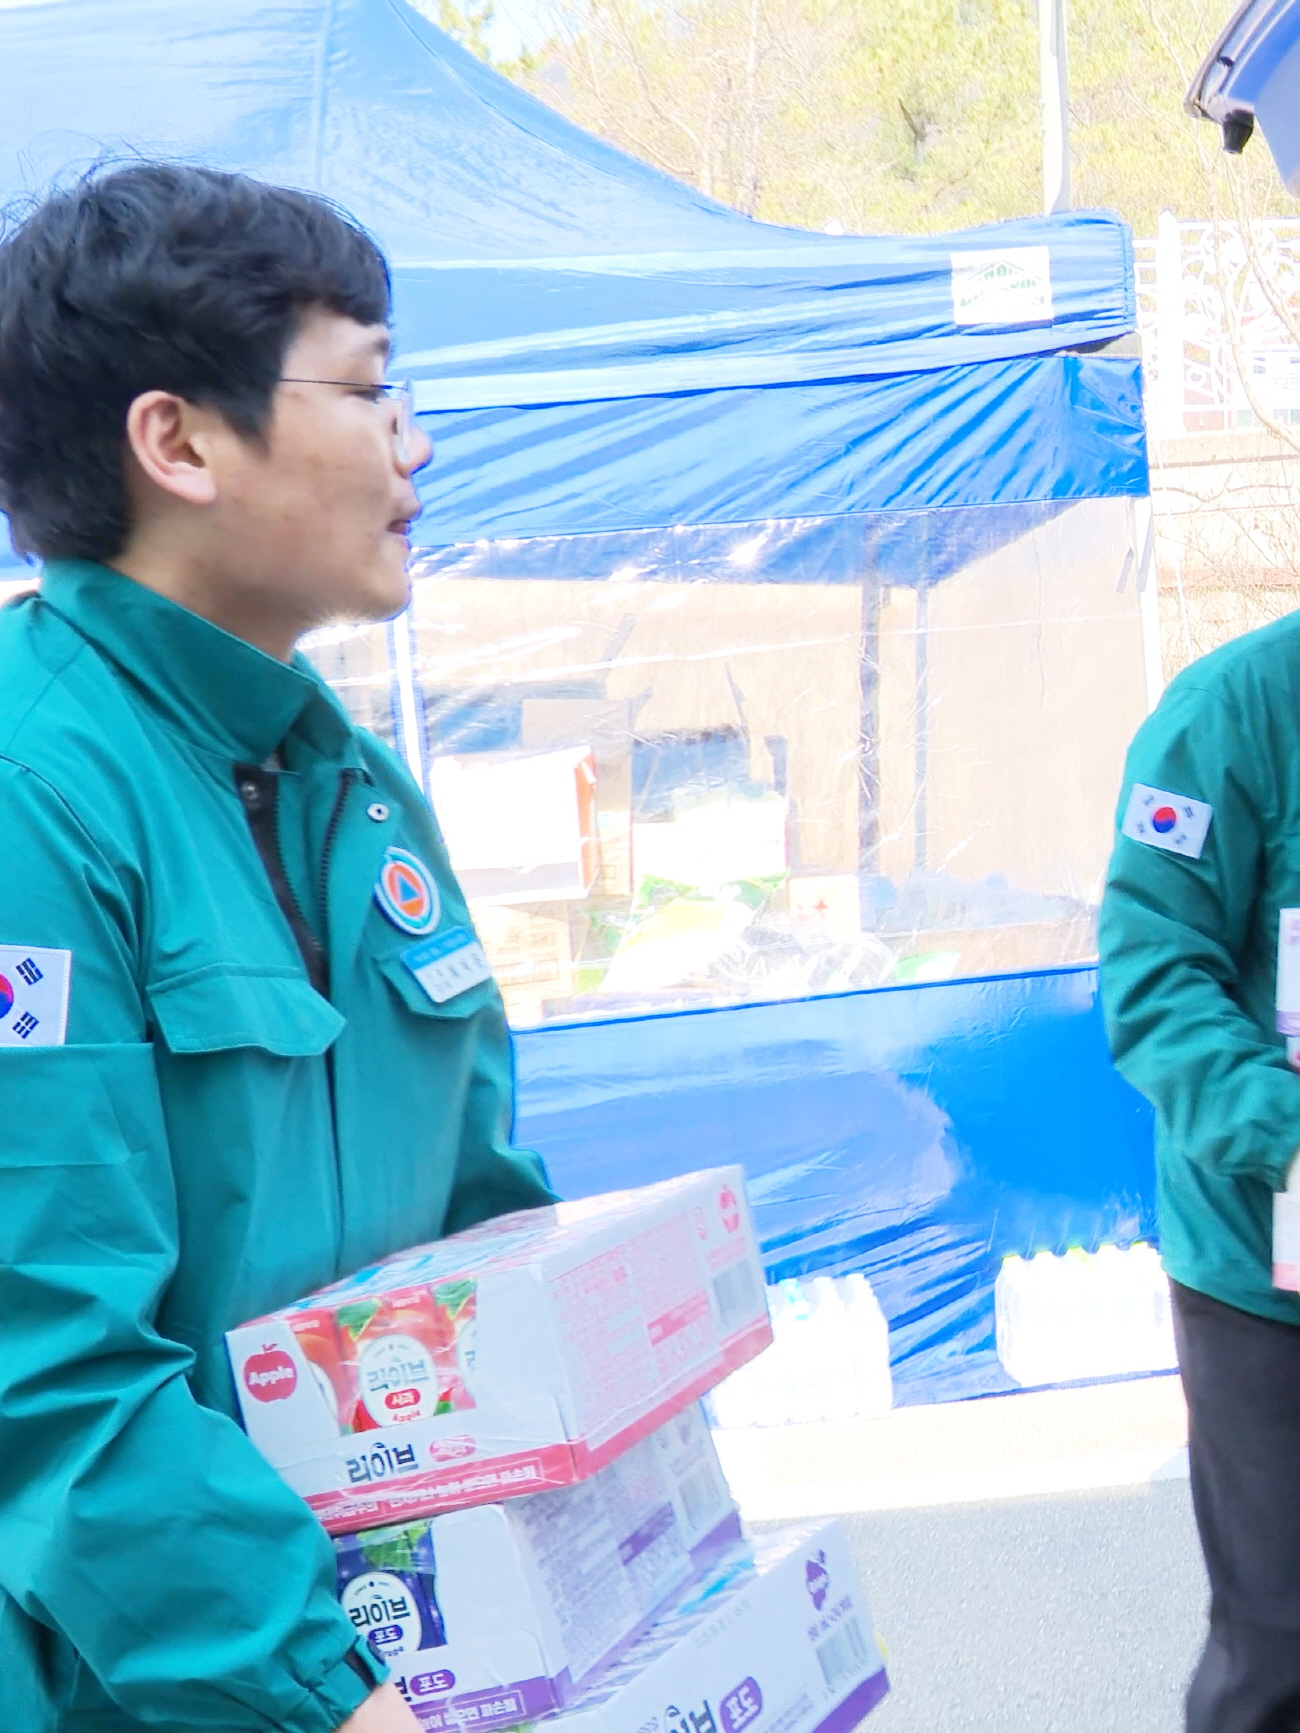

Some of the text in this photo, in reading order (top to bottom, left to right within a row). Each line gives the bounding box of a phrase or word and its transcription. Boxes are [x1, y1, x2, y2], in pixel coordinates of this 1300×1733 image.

[248, 1364, 294, 1387] Apple
[366, 1356, 430, 1392] 리이브
[345, 1442, 419, 1483] 리이브
[348, 1594, 411, 1628] 리이브
[373, 1627, 398, 1641] 포도
[417, 1673, 449, 1693] 포도
[725, 1685, 759, 1730] 포도
